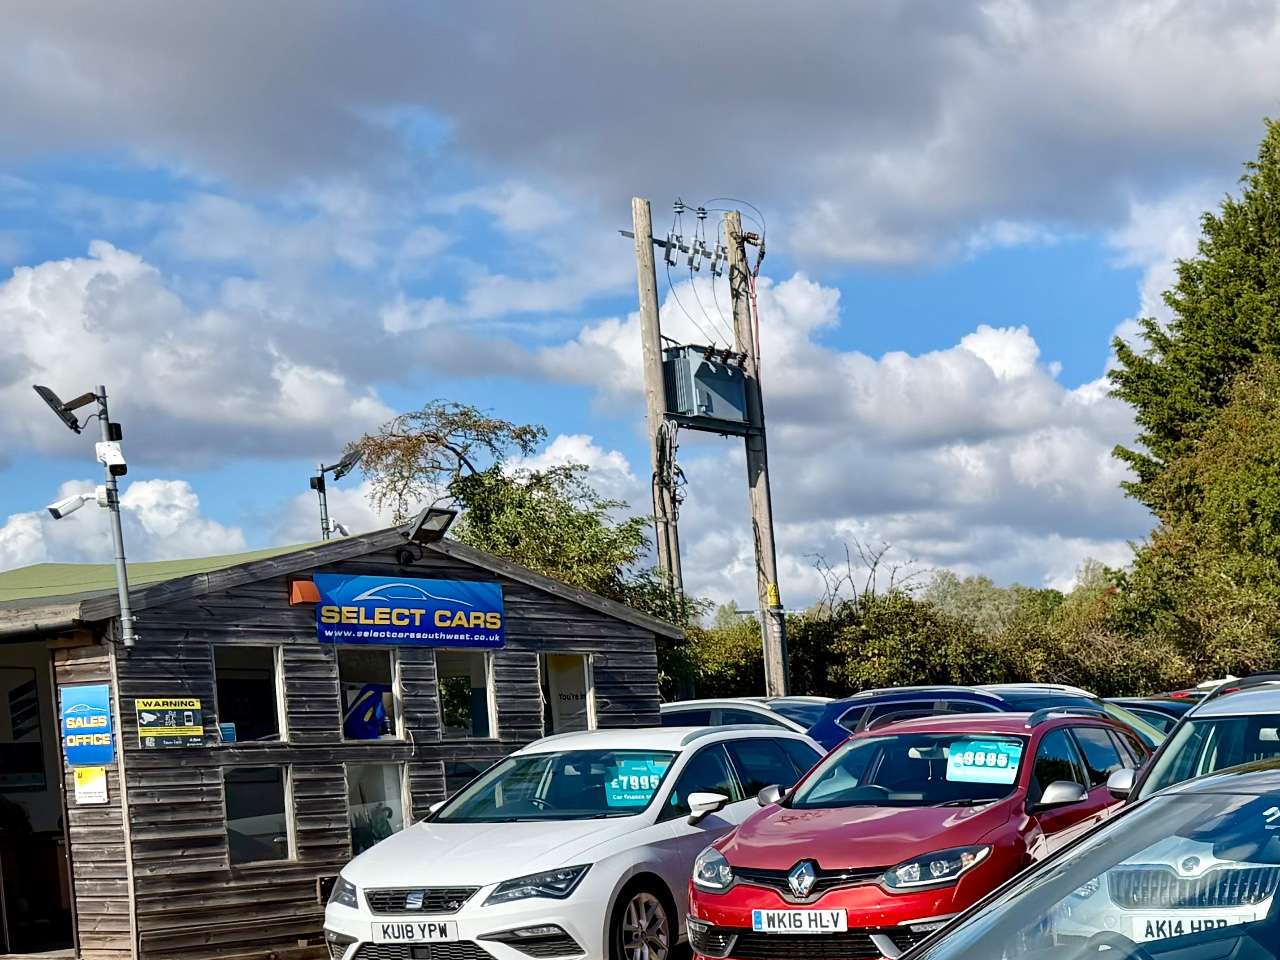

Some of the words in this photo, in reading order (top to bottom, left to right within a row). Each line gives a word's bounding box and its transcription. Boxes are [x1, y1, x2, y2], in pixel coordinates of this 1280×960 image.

[320, 605, 426, 626] SELECT
[434, 609, 501, 629] CARS
[324, 629, 500, 642] www.selectcarssouthwest.co.uk
[66, 715, 107, 728] SALES
[66, 733, 111, 747] OFFICE
[610, 774, 660, 790] £7995
[766, 912, 803, 928] WK16
[808, 912, 839, 928] HLV
[381, 924, 415, 939] KU18
[417, 923, 448, 939] YPW
[1144, 919, 1185, 938] AK14
